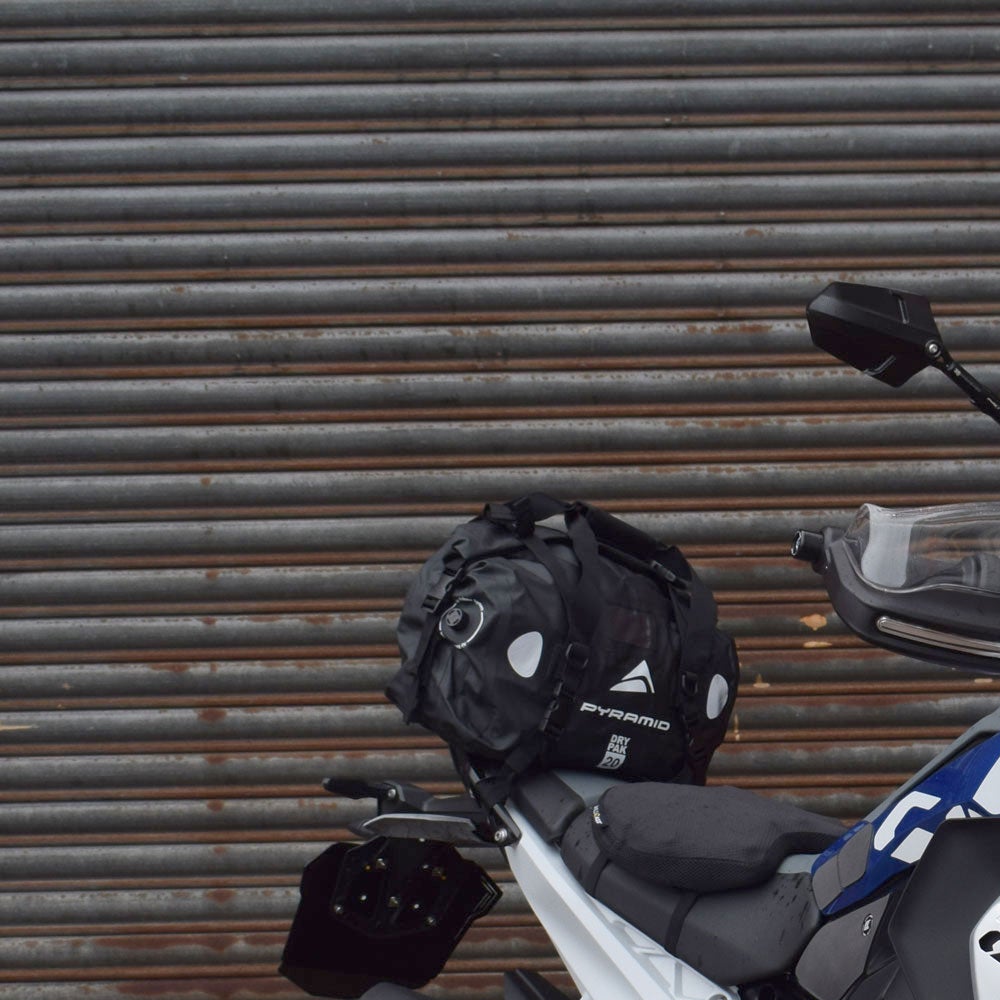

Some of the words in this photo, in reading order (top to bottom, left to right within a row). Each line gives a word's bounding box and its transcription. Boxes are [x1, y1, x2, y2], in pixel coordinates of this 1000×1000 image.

[580, 702, 670, 731] PYRAMID
[610, 734, 631, 746] DRY
[606, 743, 628, 755] PAK
[603, 756, 620, 768] 20
